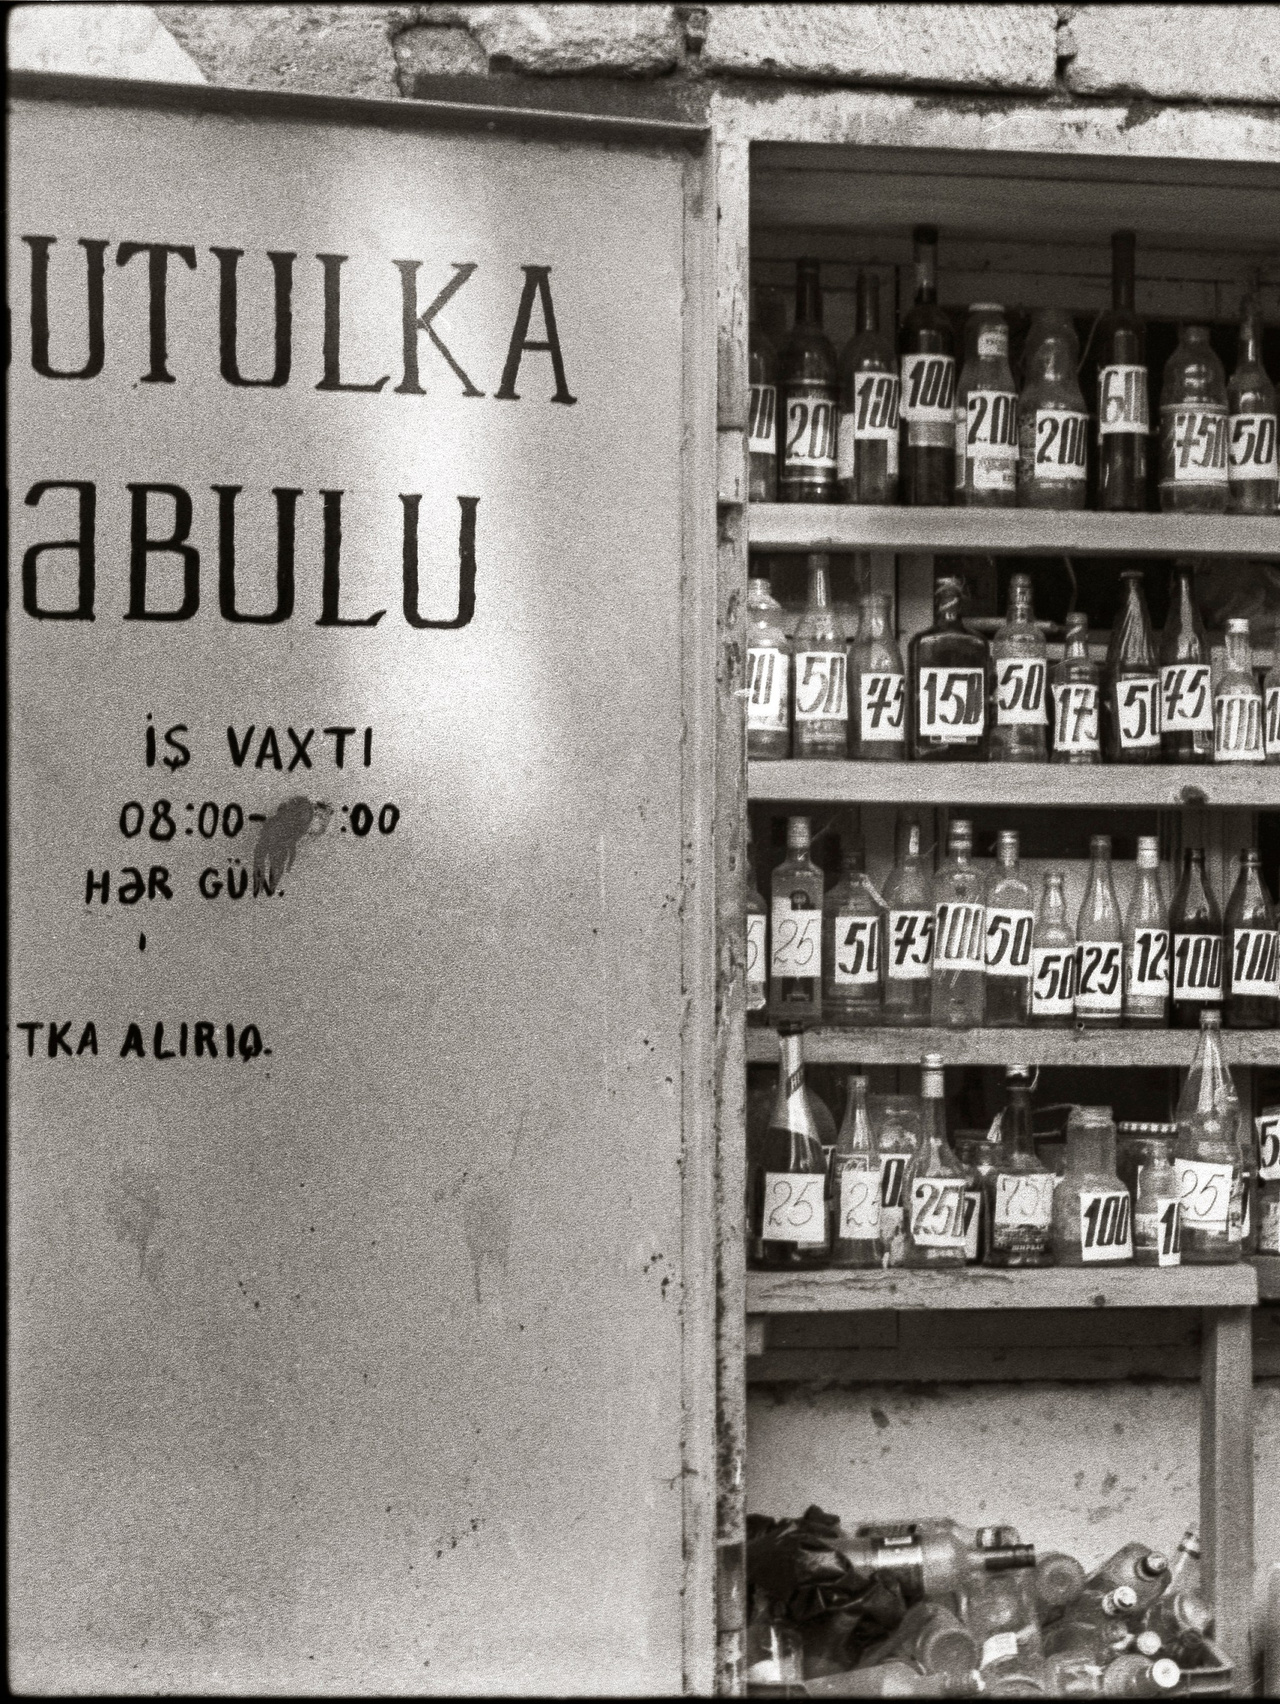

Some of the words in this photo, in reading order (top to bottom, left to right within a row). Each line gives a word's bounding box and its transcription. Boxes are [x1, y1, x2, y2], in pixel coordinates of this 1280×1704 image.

[6, 235, 578, 405] UTULKA
[1229, 419, 1275, 465] 50
[797, 656, 846, 713] 50
[867, 677, 906, 728] 75
[923, 672, 983, 725] 150
[999, 664, 1044, 711] 50
[1163, 669, 1209, 721] 75
[227, 725, 373, 772] VAXTI
[773, 918, 820, 966] 25
[895, 915, 935, 965] 75
[984, 915, 1034, 966] 50
[1137, 932, 1170, 983] 12
[1176, 938, 1222, 988] 100
[1234, 932, 1279, 982] 100
[1034, 954, 1076, 1000] 50
[1075, 945, 1120, 996] 125
[16, 1021, 99, 1058] TKA
[768, 1181, 818, 1227] 25
[1181, 1169, 1225, 1217] 25
[1084, 1195, 1130, 1248] 100
